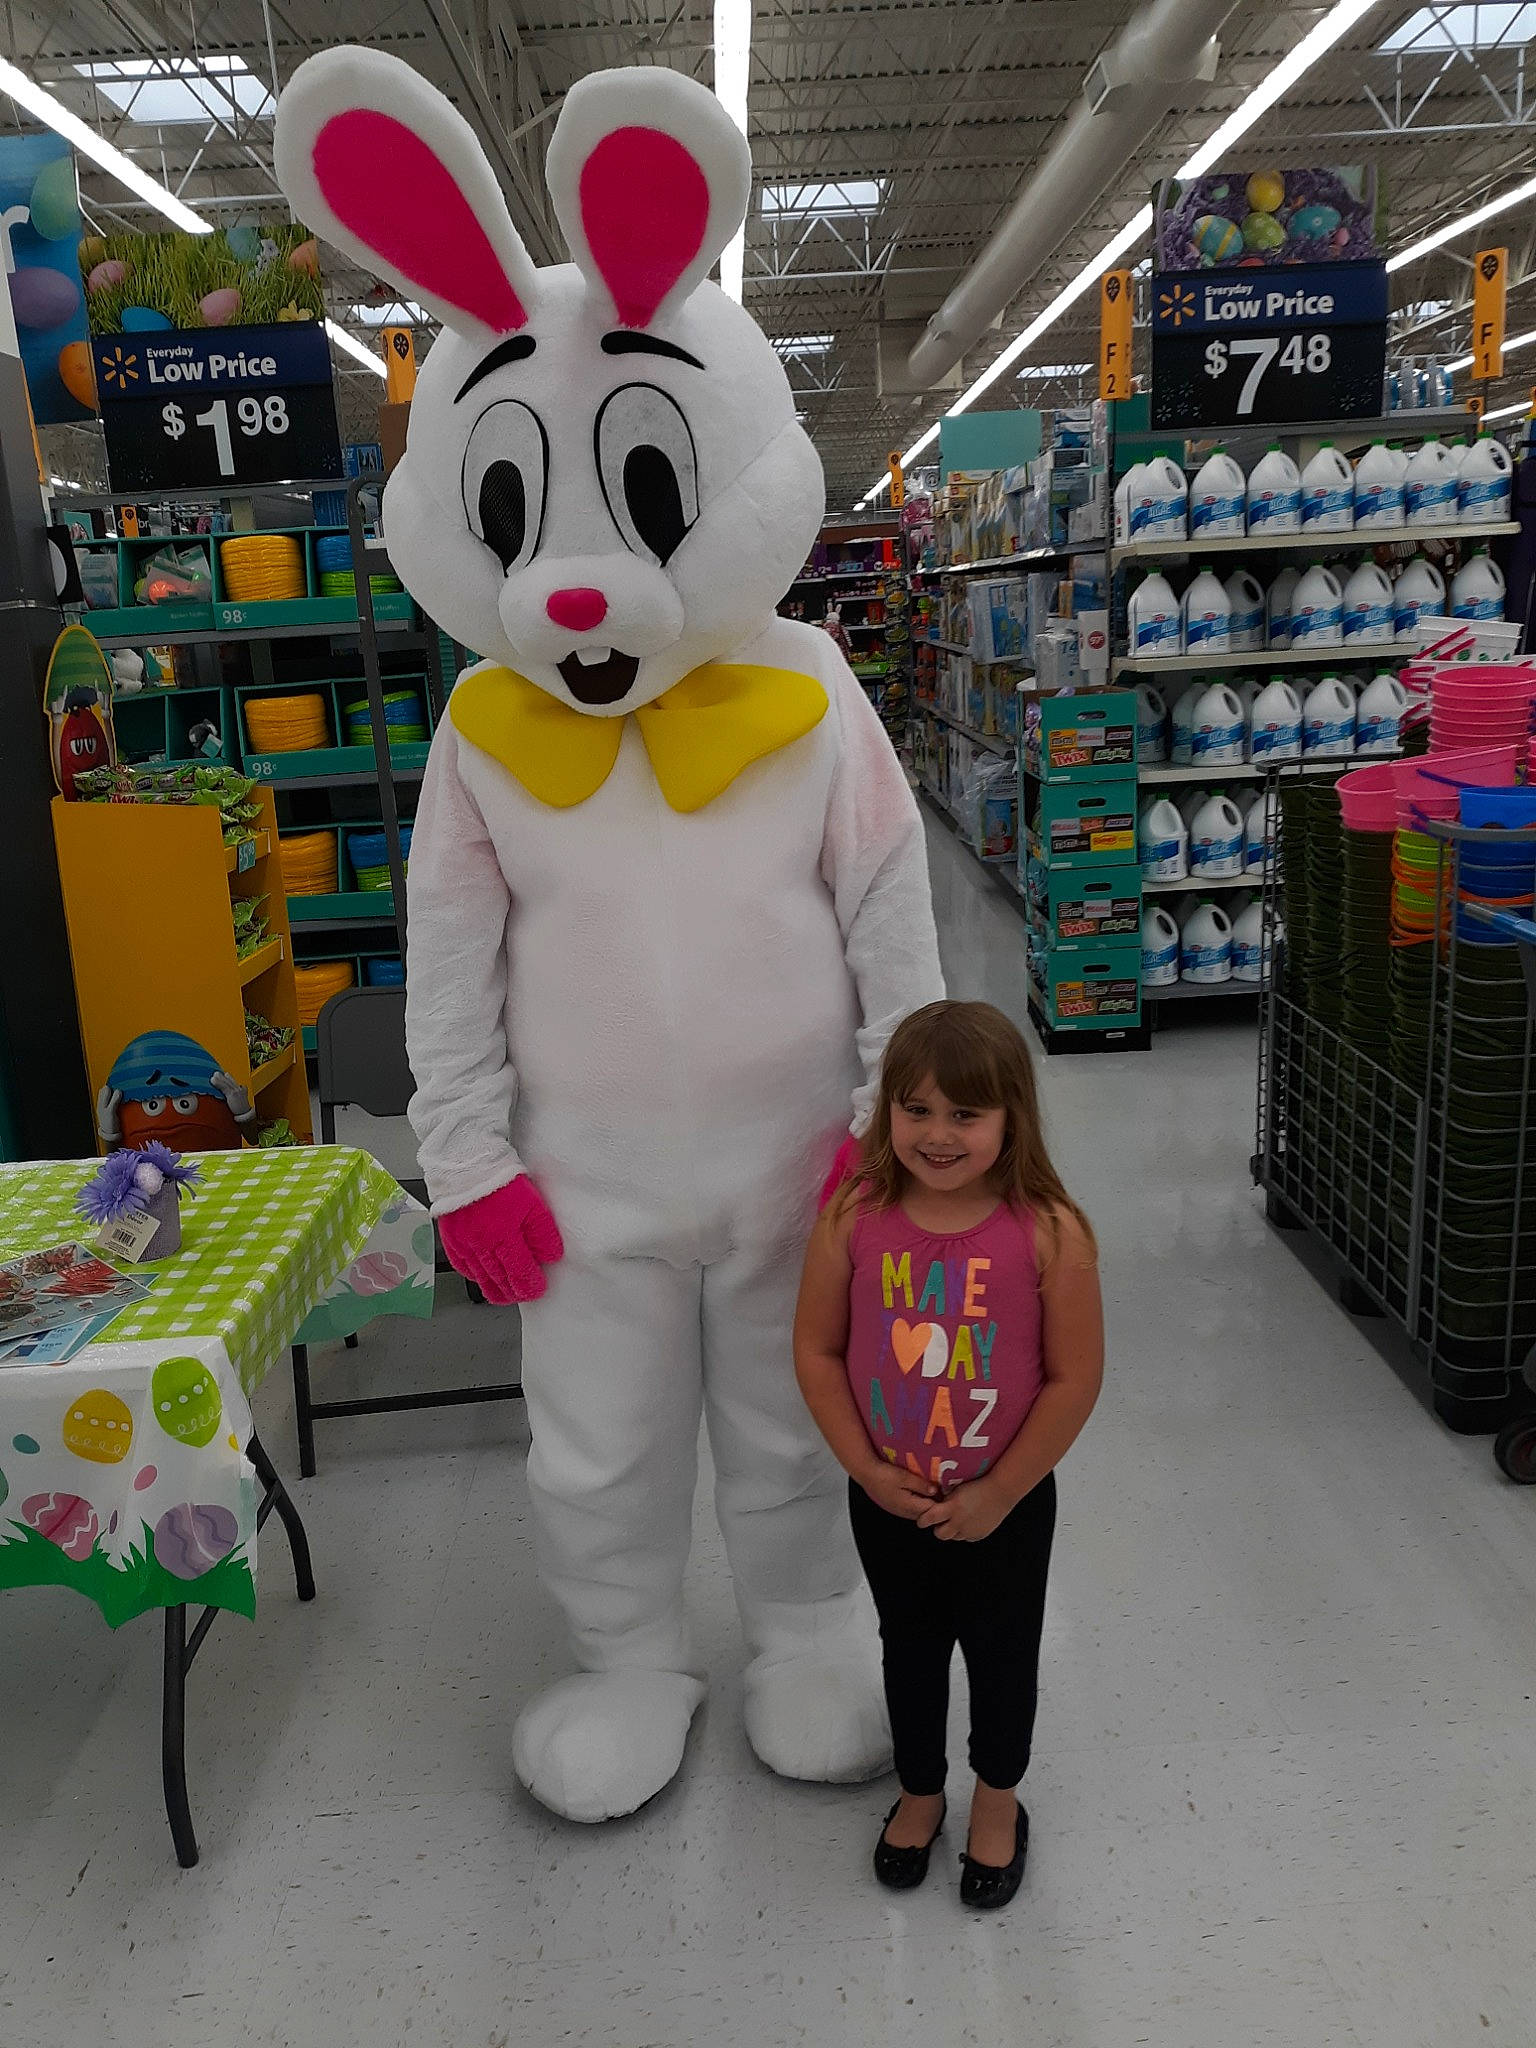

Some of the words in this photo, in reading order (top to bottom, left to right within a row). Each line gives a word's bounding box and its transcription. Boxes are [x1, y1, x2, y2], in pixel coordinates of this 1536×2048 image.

[1205, 284, 1254, 297] Everyday
[1205, 297, 1262, 320] Low
[1266, 290, 1335, 317] Price
[1481, 322, 1494, 345] F
[146, 345, 194, 359] Everyday
[1106, 342, 1117, 365] F
[1483, 352, 1490, 372] 1
[148, 359, 204, 383] Low
[208, 351, 277, 379] Price
[1106, 373, 1116, 394] 2
